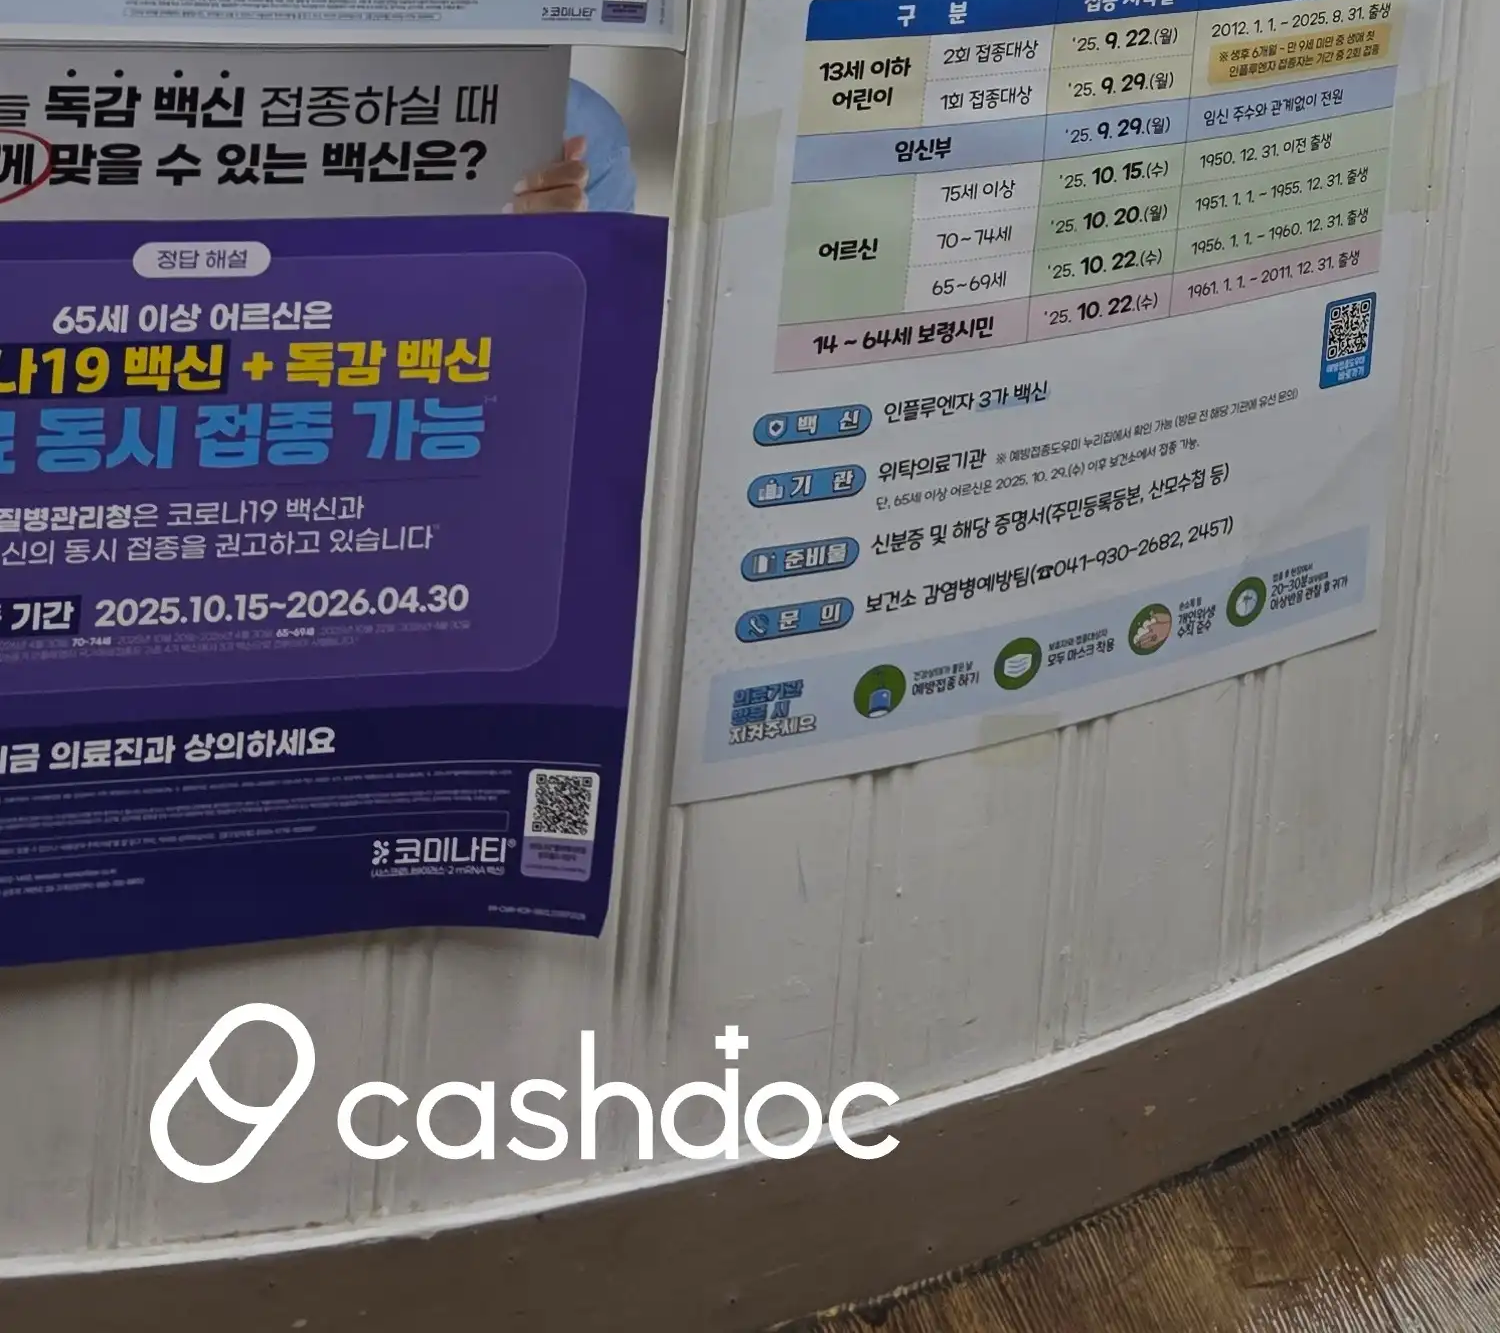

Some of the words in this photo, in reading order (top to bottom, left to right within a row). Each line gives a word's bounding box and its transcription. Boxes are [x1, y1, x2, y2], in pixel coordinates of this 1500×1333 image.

[1368, 3, 1391, 20] 출생
[943, 46, 970, 64] 2회
[975, 40, 1039, 63] 접종대상
[819, 60, 864, 82] 13세
[870, 57, 911, 77] 이하
[259, 85, 441, 127] 접종하실
[455, 83, 499, 126] 때
[832, 86, 893, 111] 어린이
[1204, 109, 1229, 127] 임신
[1233, 103, 1268, 122] 주수와
[1271, 93, 1317, 117] 관계없이
[1320, 88, 1343, 107] 전원
[895, 136, 952, 162] 임신부
[1283, 137, 1307, 155] 이전
[1310, 133, 1333, 151] 출생
[49, 144, 143, 187] 맞을
[155, 144, 202, 187] 수
[217, 141, 307, 186] 있는
[321, 140, 487, 183] 백신은?
[941, 183, 978, 203] 75세
[982, 180, 1015, 199] 이상
[819, 238, 878, 261] 어르신
[52, 305, 129, 335] 65세
[210, 300, 333, 331] 어르신은
[917, 316, 994, 345] 보령시민
[884, 393, 974, 423] 인플루엔자
[978, 388, 1009, 409] 3가
[879, 449, 986, 482] 위탁의료기관
[1148, 465, 1205, 501] 산모수첩
[285, 494, 365, 522] 백신과
[213, 529, 321, 559] 권고하고
[329, 525, 434, 555] 있습니다
[871, 526, 924, 555] 신분증
[952, 516, 990, 539] 해당
[784, 542, 848, 571] 준비물
[12, 601, 74, 631] 기간
[95, 584, 469, 628] 2025.10.15~2026.04.30
[866, 589, 917, 613] 보건소
[49, 735, 176, 771] 의료진과
[184, 726, 336, 763] 상의하세요
